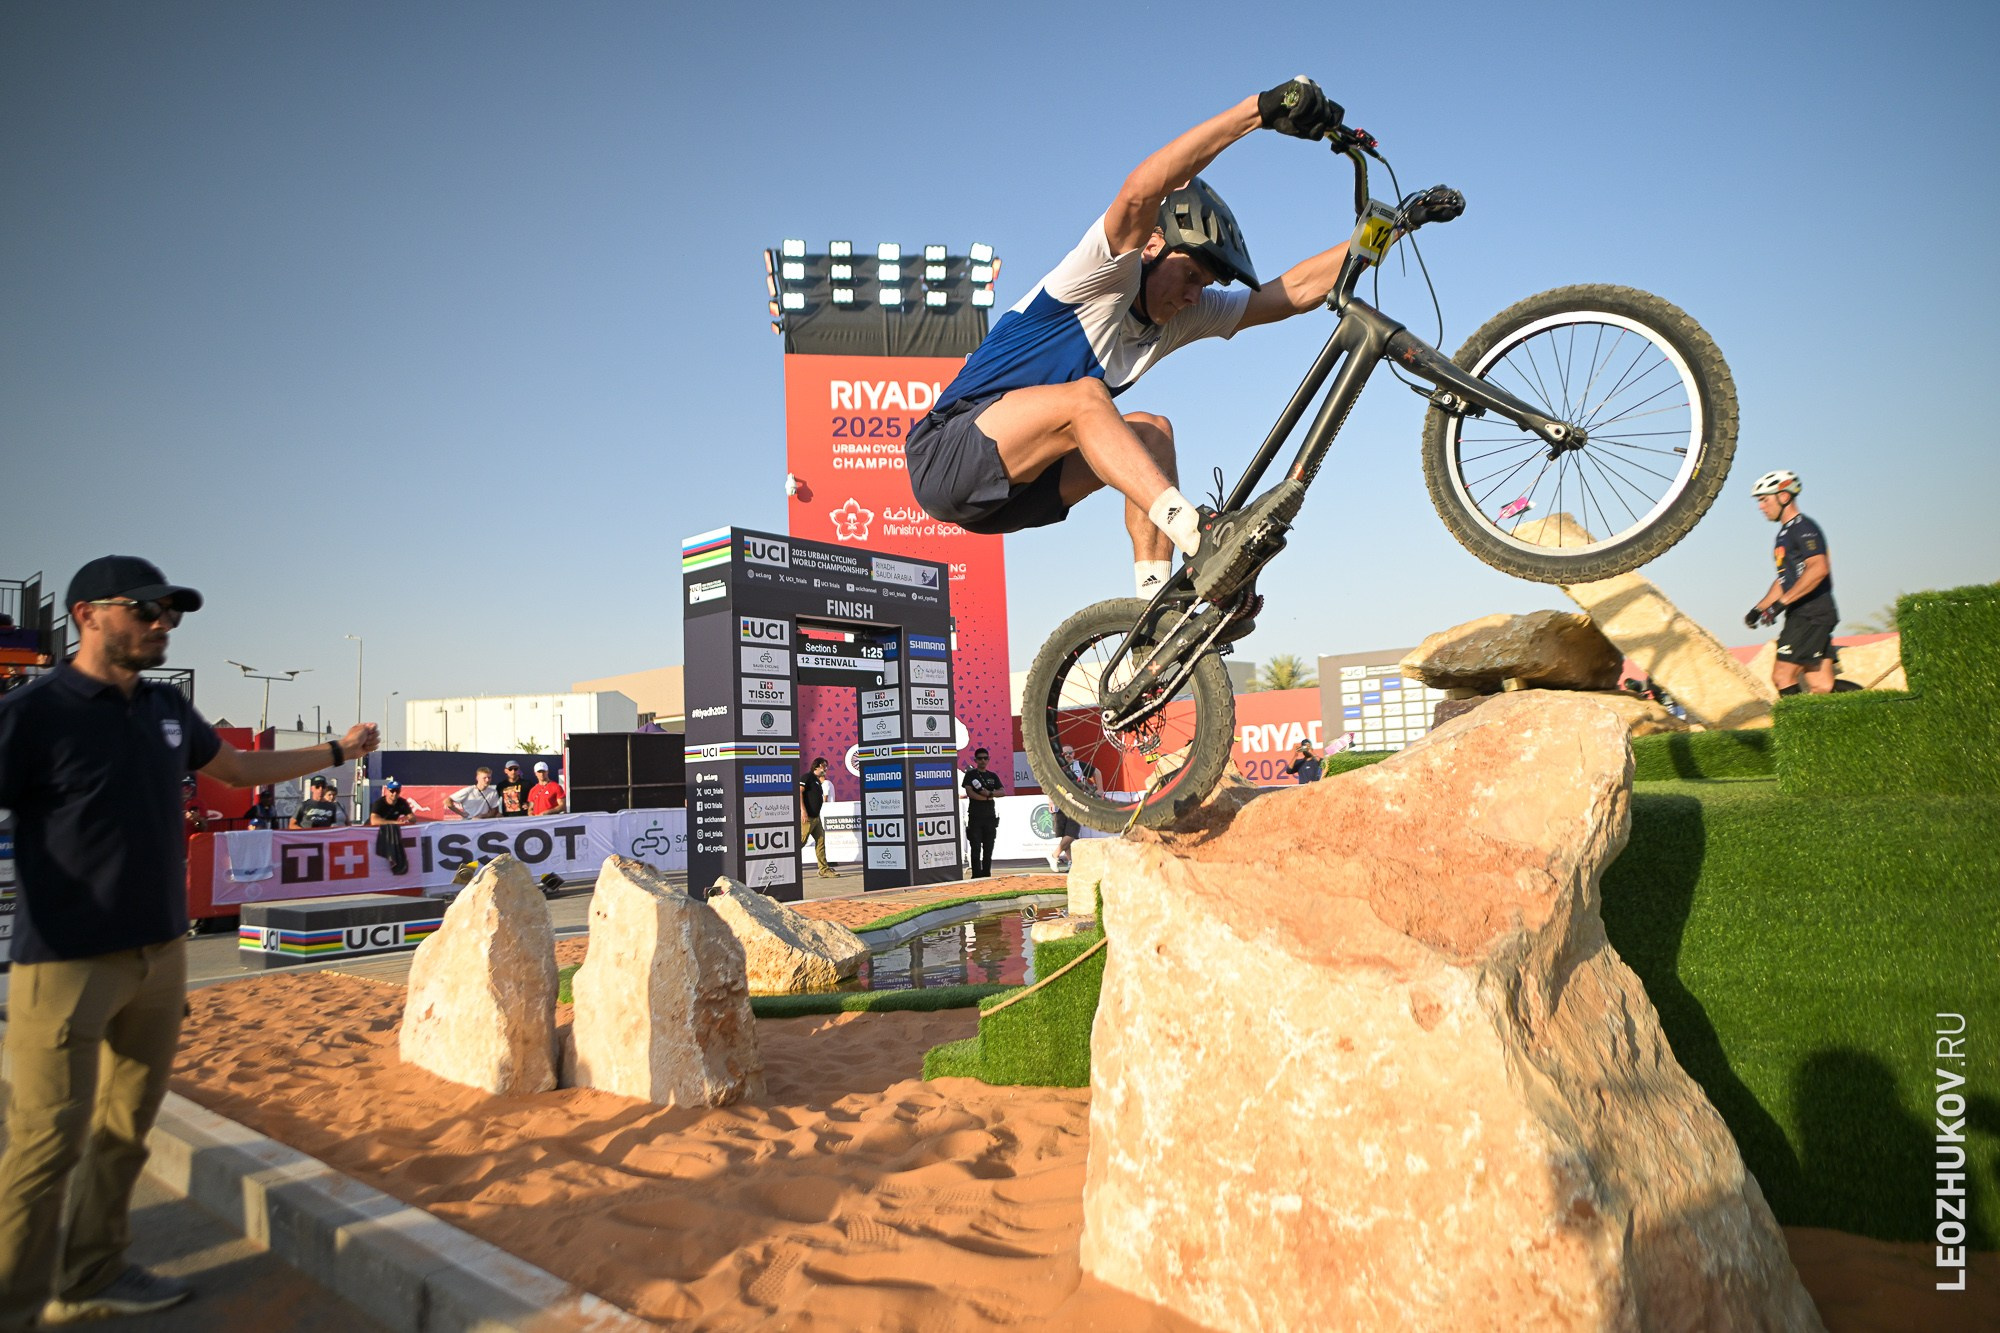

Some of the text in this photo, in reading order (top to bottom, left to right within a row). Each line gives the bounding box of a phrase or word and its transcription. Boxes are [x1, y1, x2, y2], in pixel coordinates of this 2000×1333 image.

[832, 416, 901, 438] 2025
[832, 444, 905, 454] URBAN CYCLI
[832, 458, 908, 469] CHAMPIO
[883, 524, 922, 537] Ministry
[924, 524, 935, 535] of
[752, 542, 786, 563] UCI
[791, 548, 857, 566] 2025 URBAN CYCLING
[791, 557, 869, 576] WORLD CHAMPIONSHIPS
[875, 562, 896, 571] RIYADH
[875, 570, 913, 582] SAUDI ARABIA
[826, 599, 874, 619] FINISH
[750, 621, 784, 641] UCI
[805, 643, 838, 654] Section 5
[909, 640, 946, 651] SHIMANO
[861, 646, 884, 659] 1:25
[801, 656, 858, 668] 12 STENVALL
[876, 675, 883, 686] 0
[748, 689, 785, 700] TISSOT
[866, 699, 894, 709] TISSOT
[916, 697, 944, 706] TISSOT
[691, 706, 728, 719] #Riyadh2025
[1241, 720, 1323, 754] RIYAD
[702, 747, 718, 758] UCI
[758, 745, 778, 755] UCI
[874, 747, 890, 757] UCI
[924, 745, 940, 754] UCI
[915, 770, 952, 779] SHIMANO
[1245, 758, 1299, 781] 202
[744, 773, 792, 784] SHIMANO
[865, 771, 902, 782] SHIMANO
[1014, 771, 1029, 781] BIA
[704, 802, 712, 810] UCI
[873, 822, 901, 838] UCI
[925, 820, 951, 837] UCI
[755, 831, 790, 850] UCI
[402, 825, 586, 874] ISSOT
[261, 929, 279, 951] UCI
[346, 924, 400, 950] UCI
